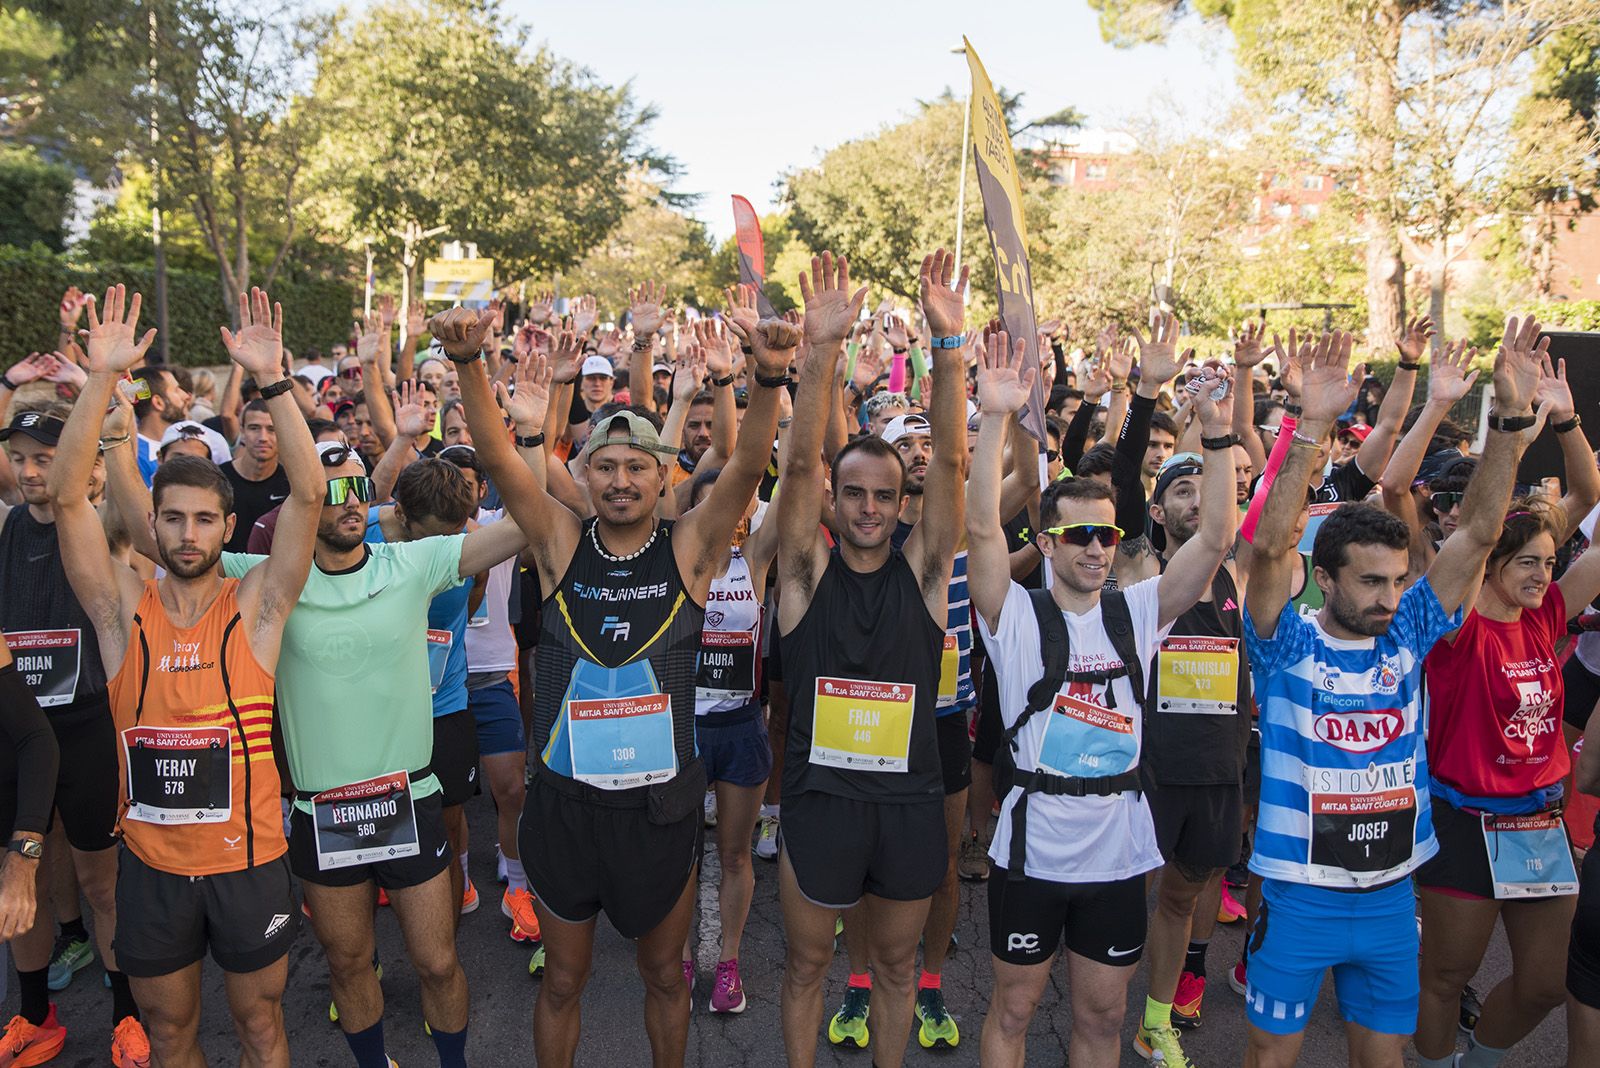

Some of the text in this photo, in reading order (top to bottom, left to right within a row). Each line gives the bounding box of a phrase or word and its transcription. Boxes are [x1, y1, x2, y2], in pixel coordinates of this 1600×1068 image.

[1120, 408, 1132, 440] KIPRUN
[573, 581, 668, 601] FUNRUNNERS
[707, 590, 753, 601] DEAUX
[37, 638, 62, 646] CUGAT
[17, 656, 53, 671] BRIAN
[703, 652, 734, 667] LAURA
[1094, 660, 1123, 672] CUGA
[25, 674, 43, 685] 297
[713, 669, 723, 679] 87
[849, 689, 870, 698] SANT
[870, 690, 895, 699] CUGAT
[1318, 691, 1365, 707] Telecom
[1526, 689, 1552, 706] 10K
[603, 700, 636, 709] UNIVERSAE
[603, 708, 623, 716] SANT
[625, 704, 651, 714] CUGAT
[848, 708, 880, 727] FRAN
[1087, 713, 1109, 726] SANT
[1325, 716, 1392, 742] DANI
[1504, 717, 1556, 738] CUGAT
[135, 736, 155, 746] MITJA
[157, 738, 178, 747] SANT
[179, 738, 209, 747] CUGAT
[612, 747, 636, 761] 1308
[155, 759, 197, 777] YERAY
[165, 781, 185, 795] 578
[321, 792, 343, 800] MITJA
[345, 789, 365, 797] SANT
[366, 783, 390, 794] CUGAT
[333, 799, 397, 824] BERNARDO
[1321, 797, 1408, 811] MITJA SANT CUGAT 23
[357, 822, 376, 837] 560
[1348, 821, 1389, 842] JOSEP
[1364, 844, 1370, 858] 1
[1007, 932, 1039, 951] pc
